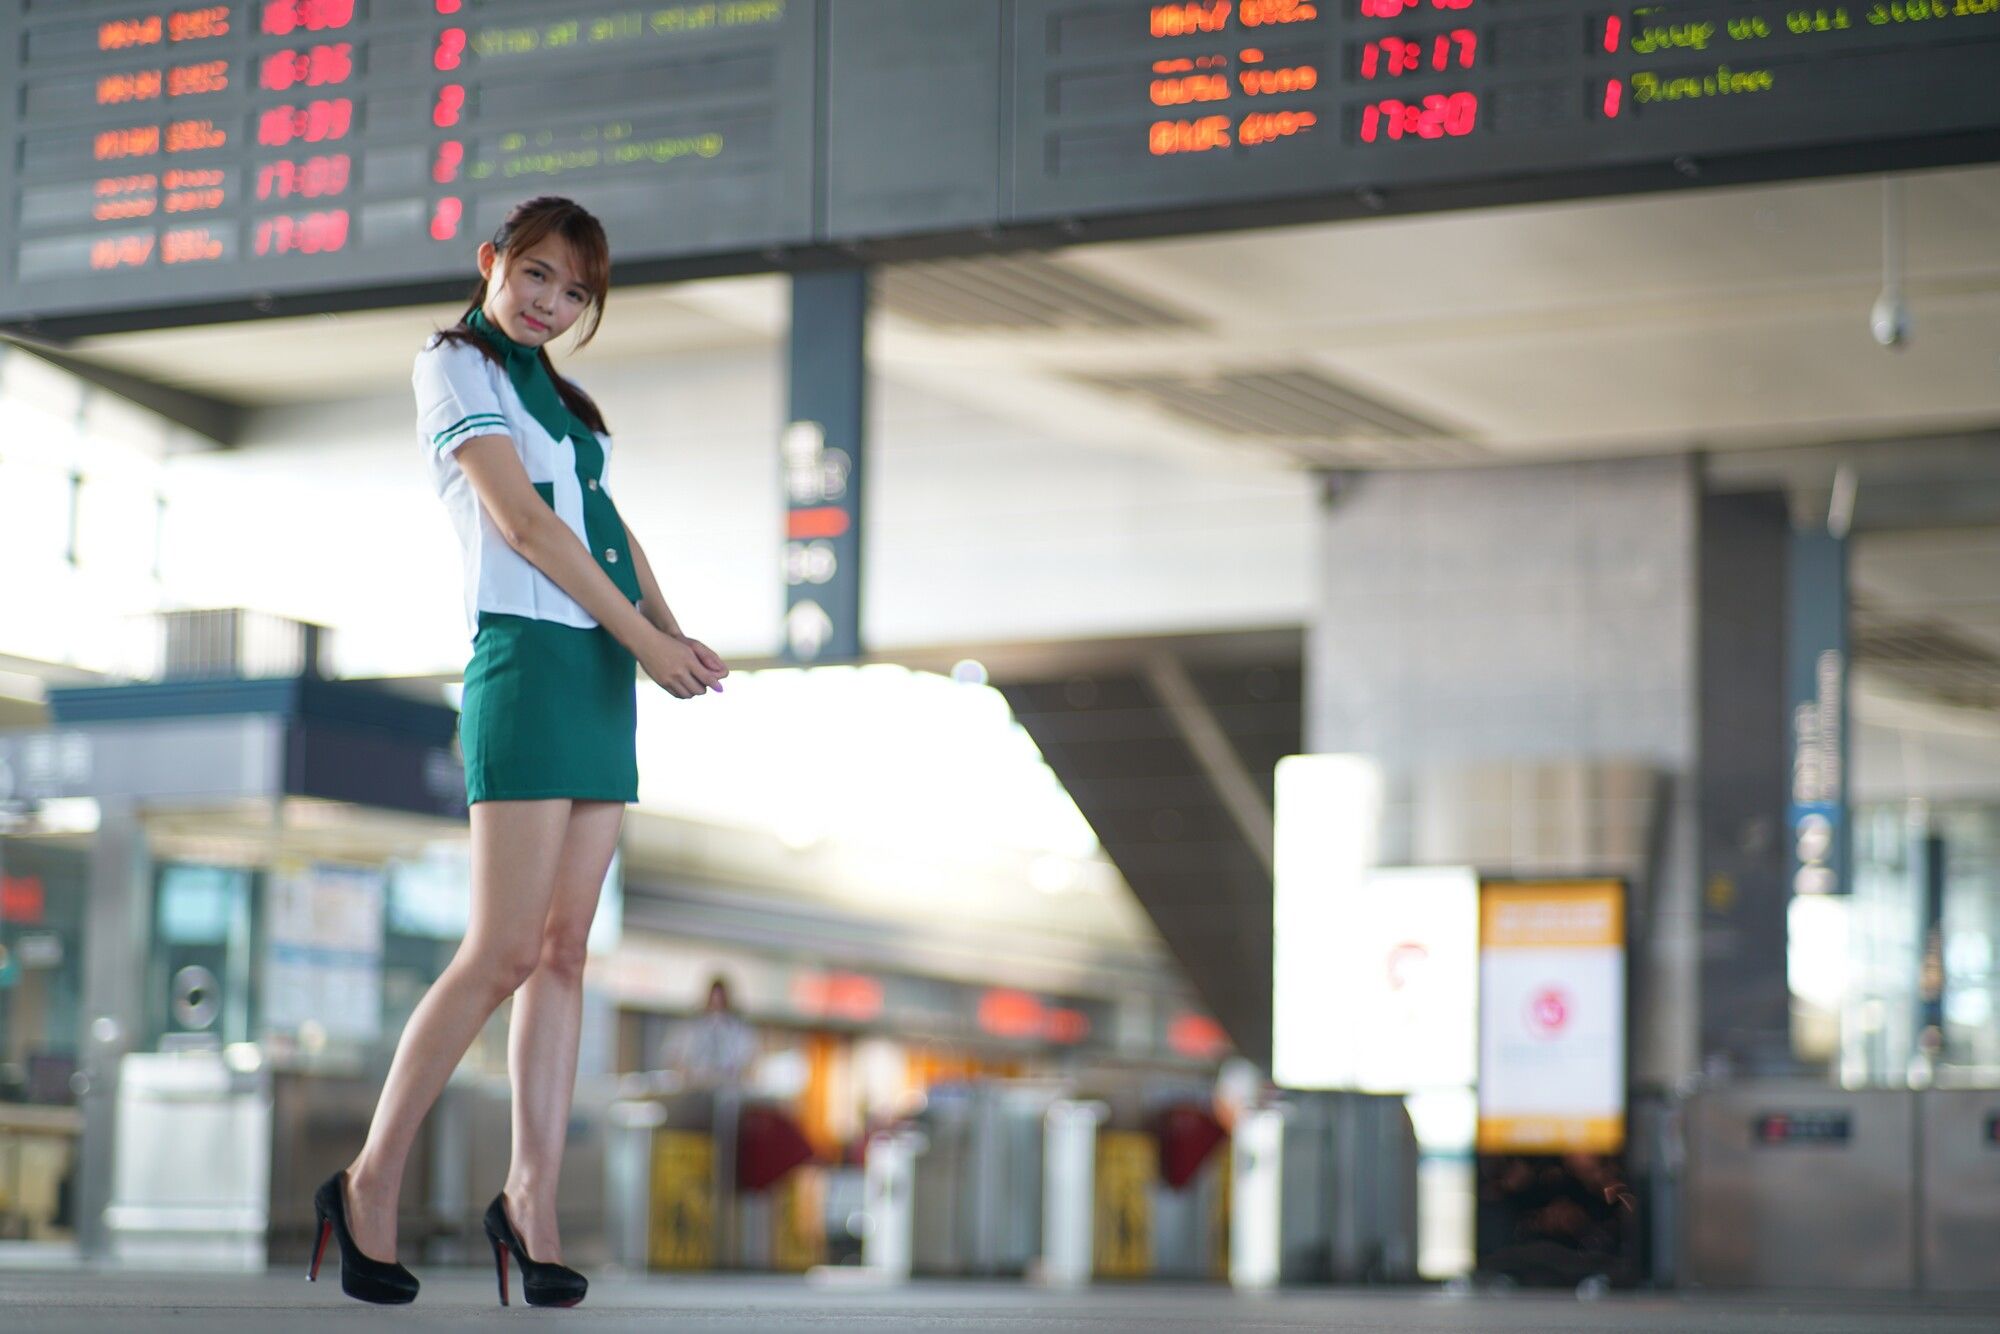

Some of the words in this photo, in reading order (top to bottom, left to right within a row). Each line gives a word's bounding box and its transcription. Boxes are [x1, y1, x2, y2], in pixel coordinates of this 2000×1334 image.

[1360, 28, 1478, 81] 17:17
[1603, 14, 1622, 54] 1
[1360, 91, 1478, 144] 17:20
[1603, 78, 1622, 119] 1
